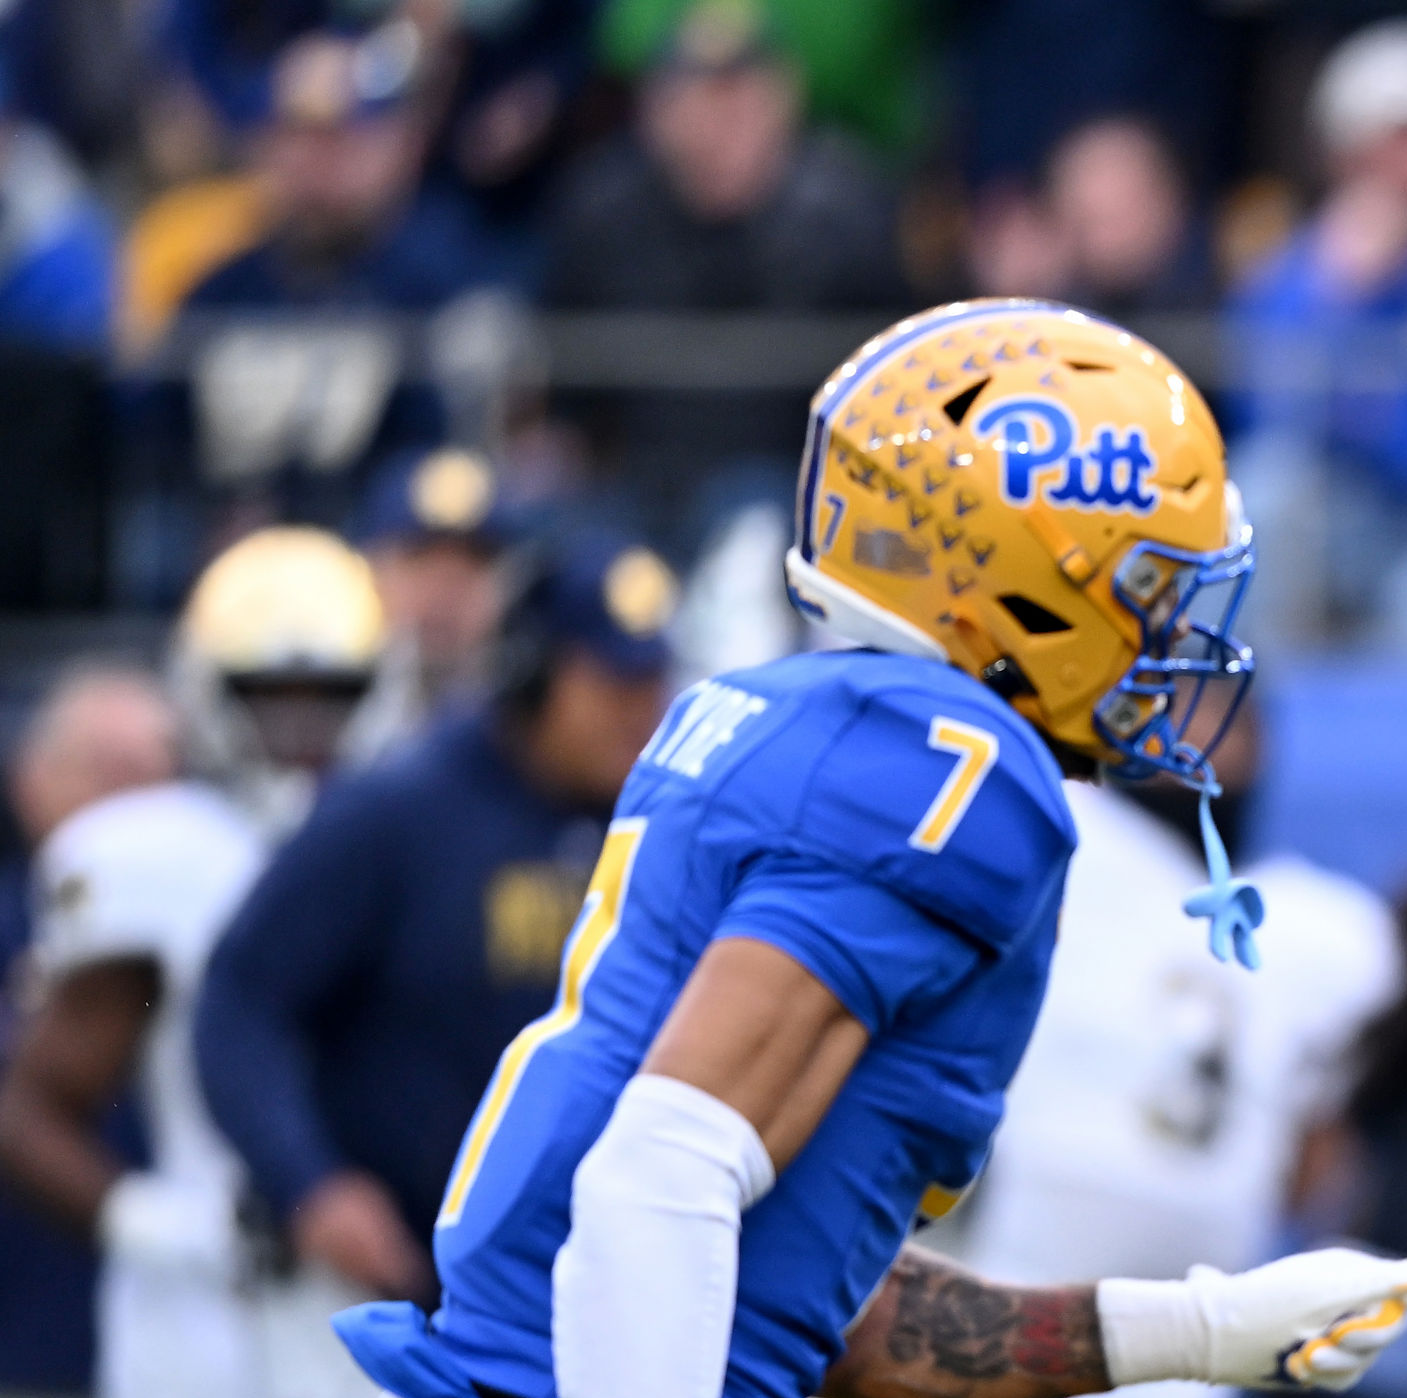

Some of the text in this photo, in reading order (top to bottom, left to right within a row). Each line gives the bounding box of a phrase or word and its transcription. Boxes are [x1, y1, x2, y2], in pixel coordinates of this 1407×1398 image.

[975, 396, 1159, 514] Pitt
[823, 495, 846, 551] 7
[908, 714, 1000, 855] 7
[436, 816, 649, 1228] 7
